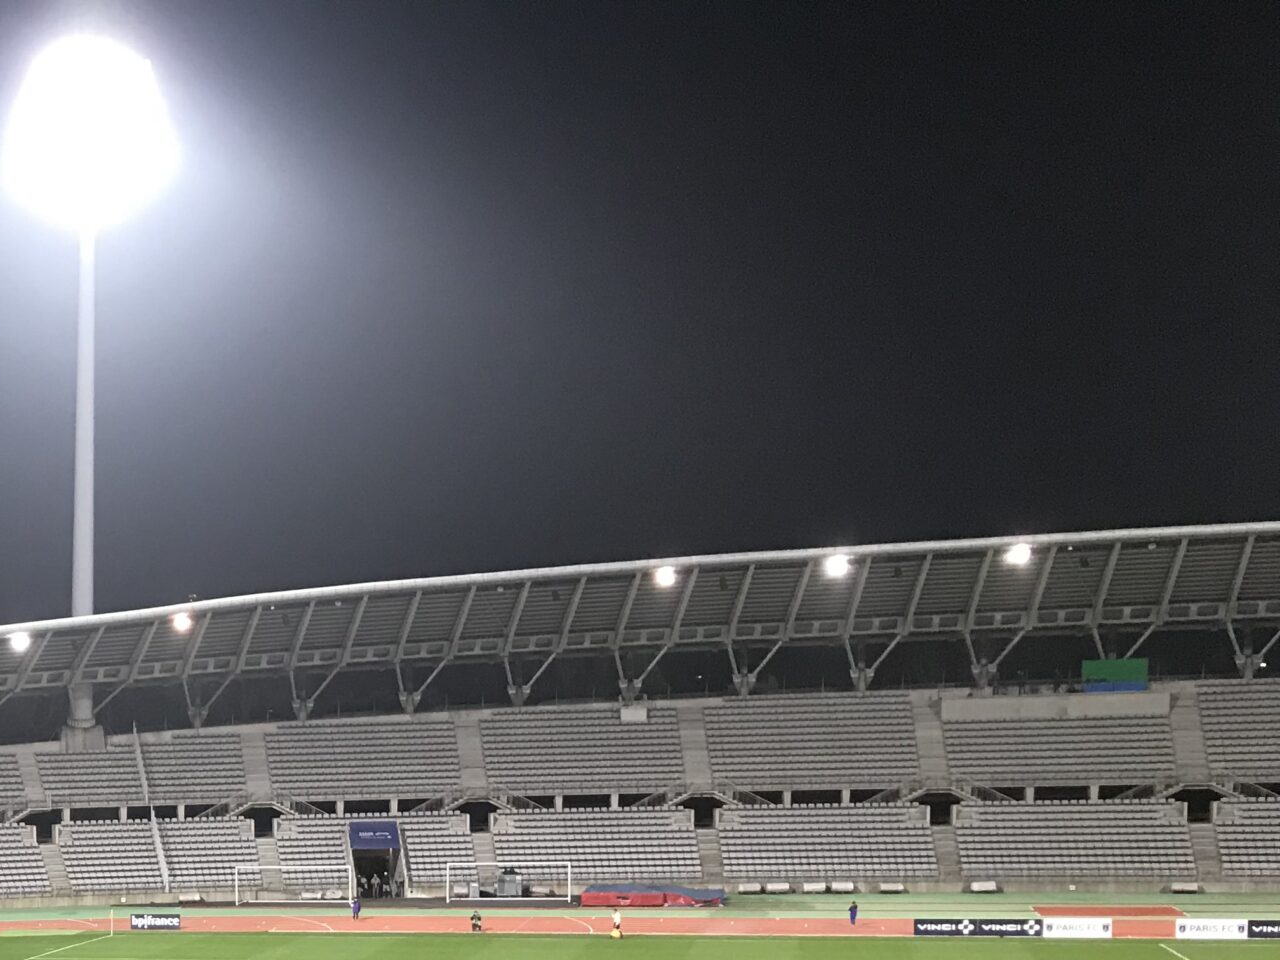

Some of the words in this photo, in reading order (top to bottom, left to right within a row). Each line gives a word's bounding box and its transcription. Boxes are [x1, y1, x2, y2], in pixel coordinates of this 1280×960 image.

[131, 914, 180, 928] bpifrance
[916, 923, 956, 931] VINCI
[981, 923, 1021, 932] VINCI
[1189, 924, 1218, 932] PARIS
[1222, 924, 1234, 932] FC
[1251, 925, 1280, 933] VIN
